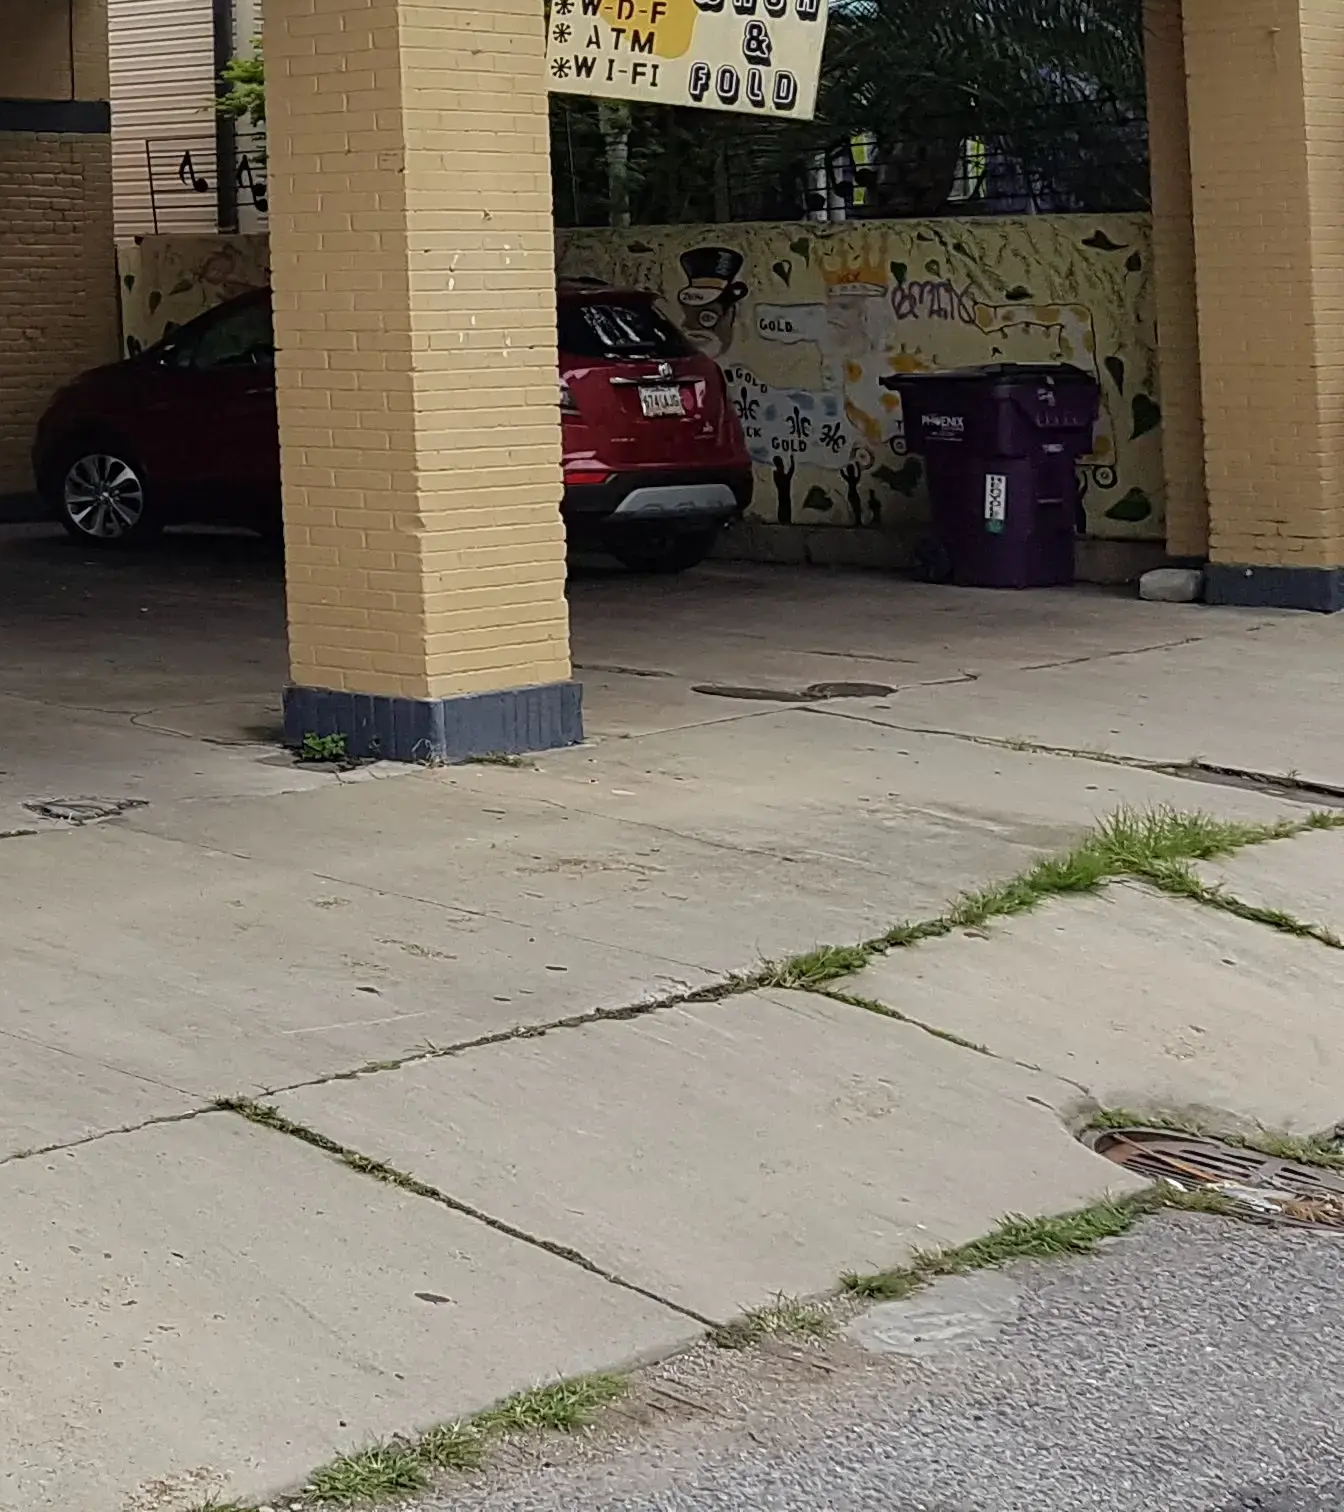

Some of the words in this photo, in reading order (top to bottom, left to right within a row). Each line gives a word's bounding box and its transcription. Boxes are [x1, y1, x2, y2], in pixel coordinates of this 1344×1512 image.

[585, 25, 656, 55] ATM
[743, 20, 773, 66] &
[573, 55, 660, 87] WI-FI
[688, 62, 798, 109] FOLD
[759, 318, 793, 333] GOLD
[735, 368, 768, 394] GOLD
[772, 437, 807, 453] GOLD
